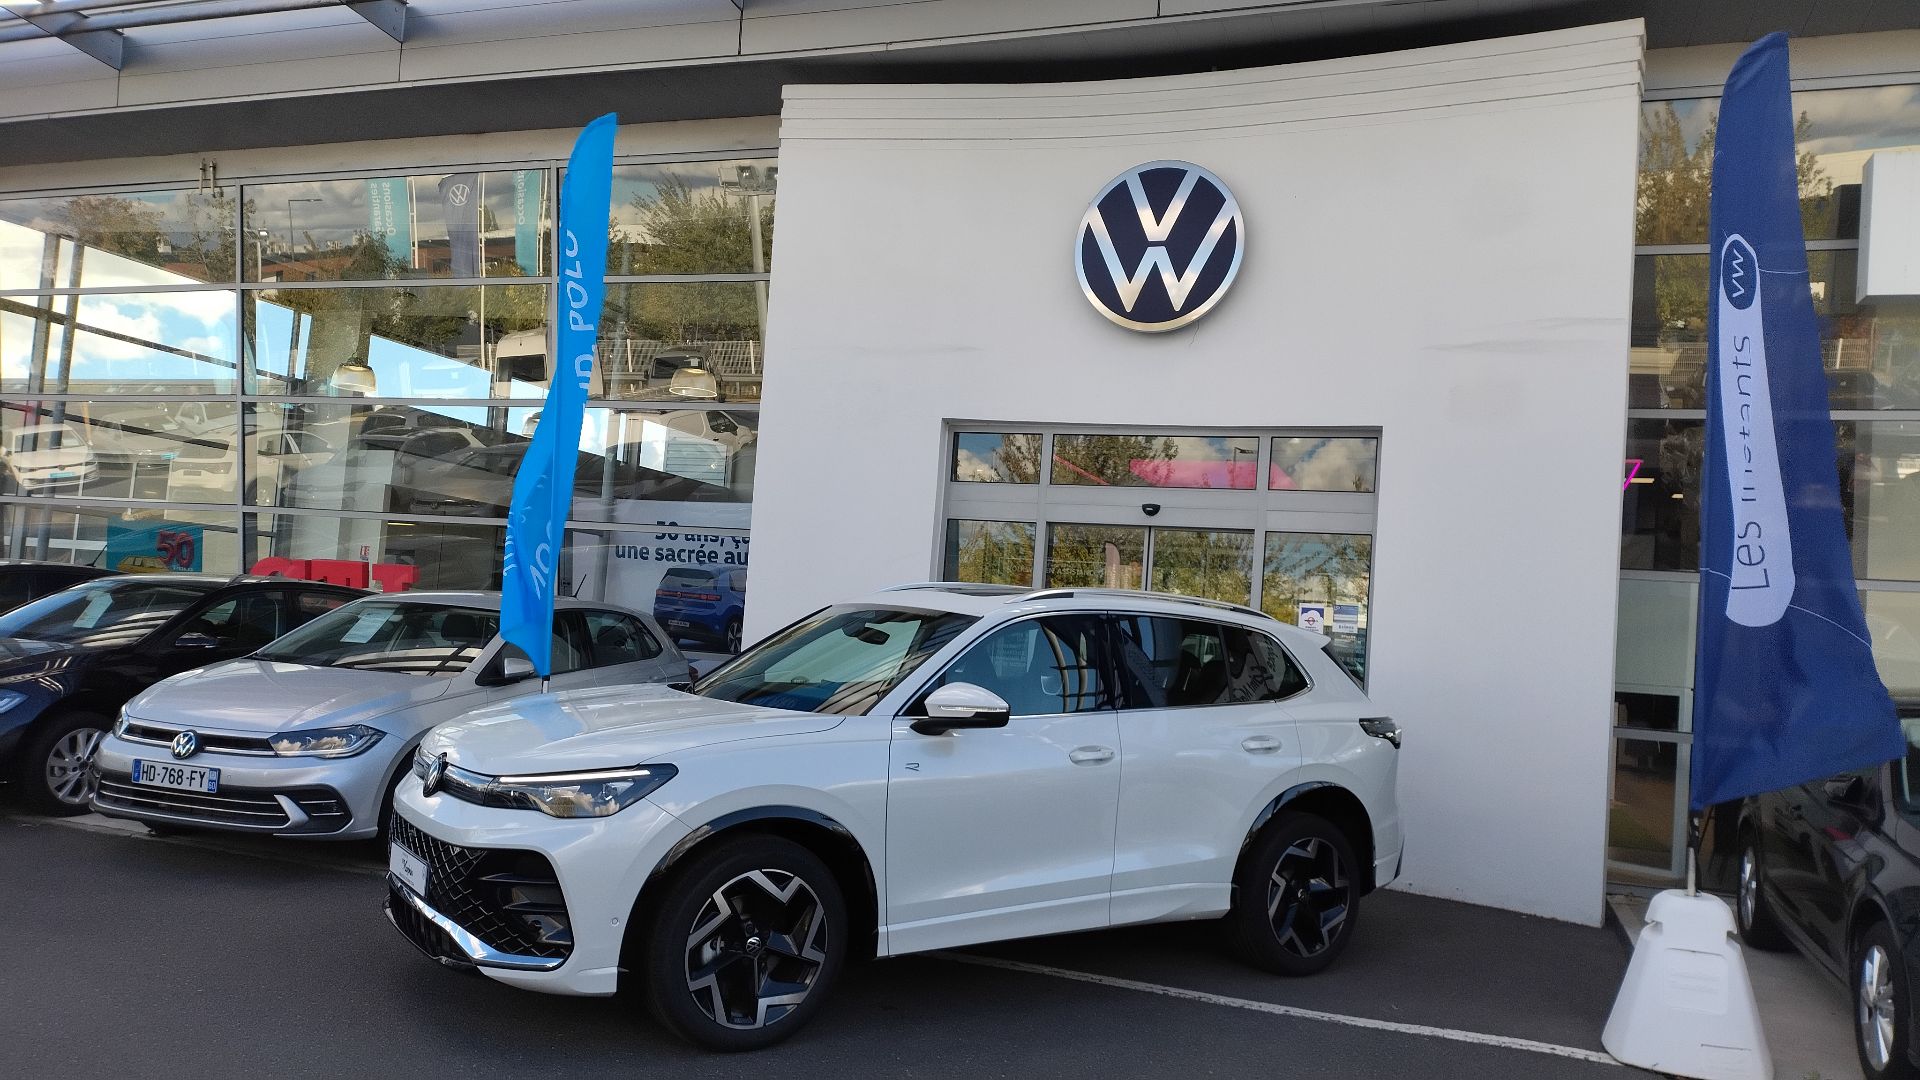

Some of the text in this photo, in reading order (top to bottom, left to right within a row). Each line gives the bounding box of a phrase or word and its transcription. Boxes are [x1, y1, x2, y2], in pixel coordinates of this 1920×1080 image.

[1075, 160, 1245, 332] VW
[156, 530, 194, 567] 50
[615, 545, 650, 561] une
[654, 543, 719, 564] sacrée
[1731, 521, 1770, 590] Les
[141, 763, 206, 788] HD-768-FY
